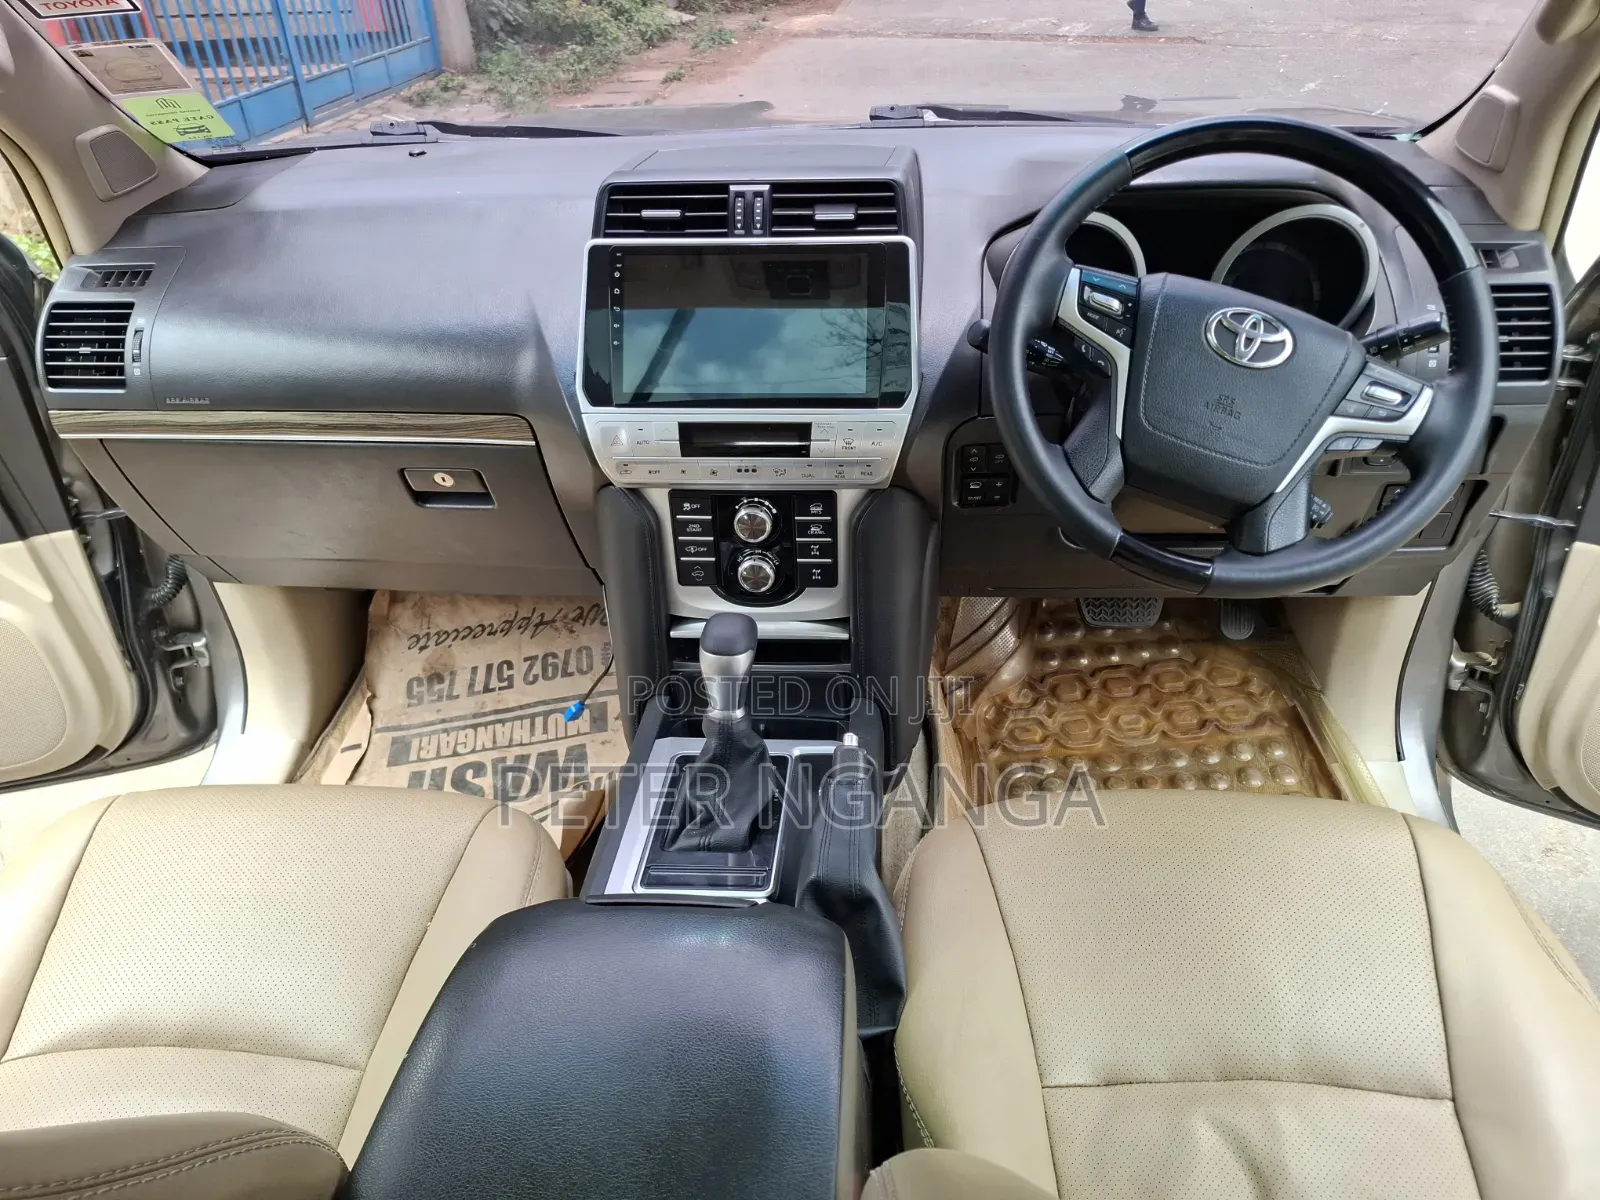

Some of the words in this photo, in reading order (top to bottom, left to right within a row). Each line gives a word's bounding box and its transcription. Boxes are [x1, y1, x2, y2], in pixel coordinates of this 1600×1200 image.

[39, 0, 119, 10] TOYOTA
[1217, 394, 1236, 406] SRS
[406, 607, 564, 654] Appreciate
[466, 659, 515, 698] 577
[522, 645, 595, 686] 0792
[406, 668, 461, 708] 755
[408, 708, 592, 762] MUTHANGARI
